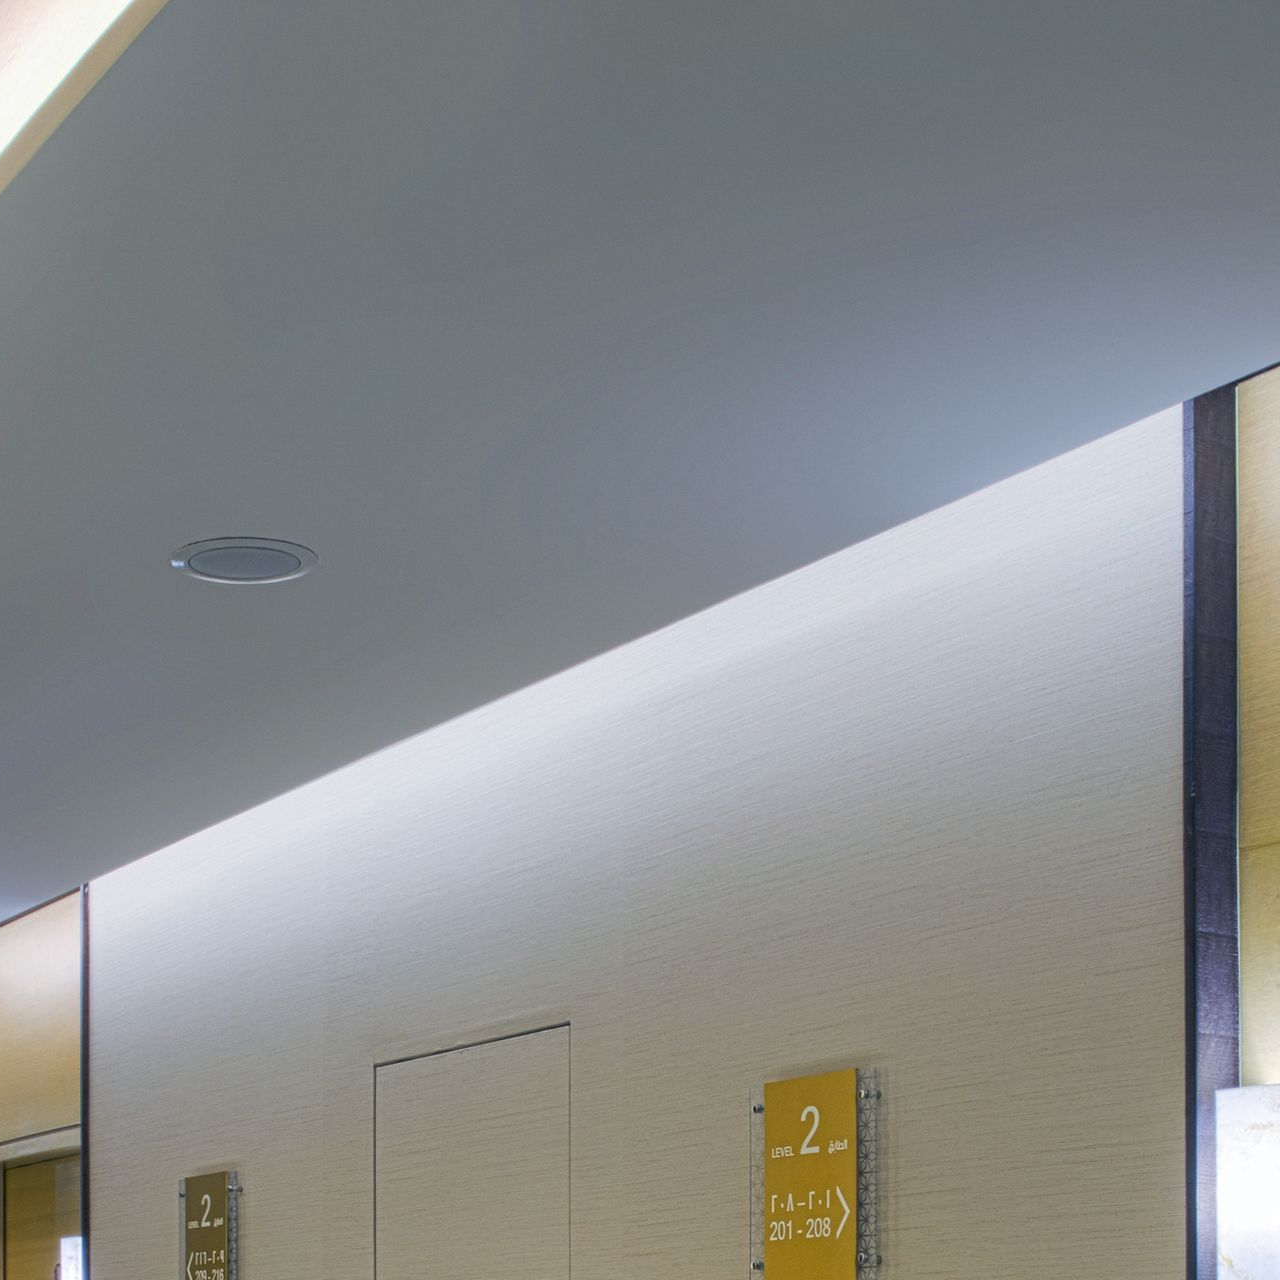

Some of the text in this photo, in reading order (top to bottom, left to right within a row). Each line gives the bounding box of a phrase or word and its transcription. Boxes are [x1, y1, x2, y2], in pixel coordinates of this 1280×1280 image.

[771, 1105, 821, 1158] LEVEL 2
[201, 1194, 211, 1227] 2
[769, 1220, 793, 1241] 201
[805, 1217, 831, 1239] 208
